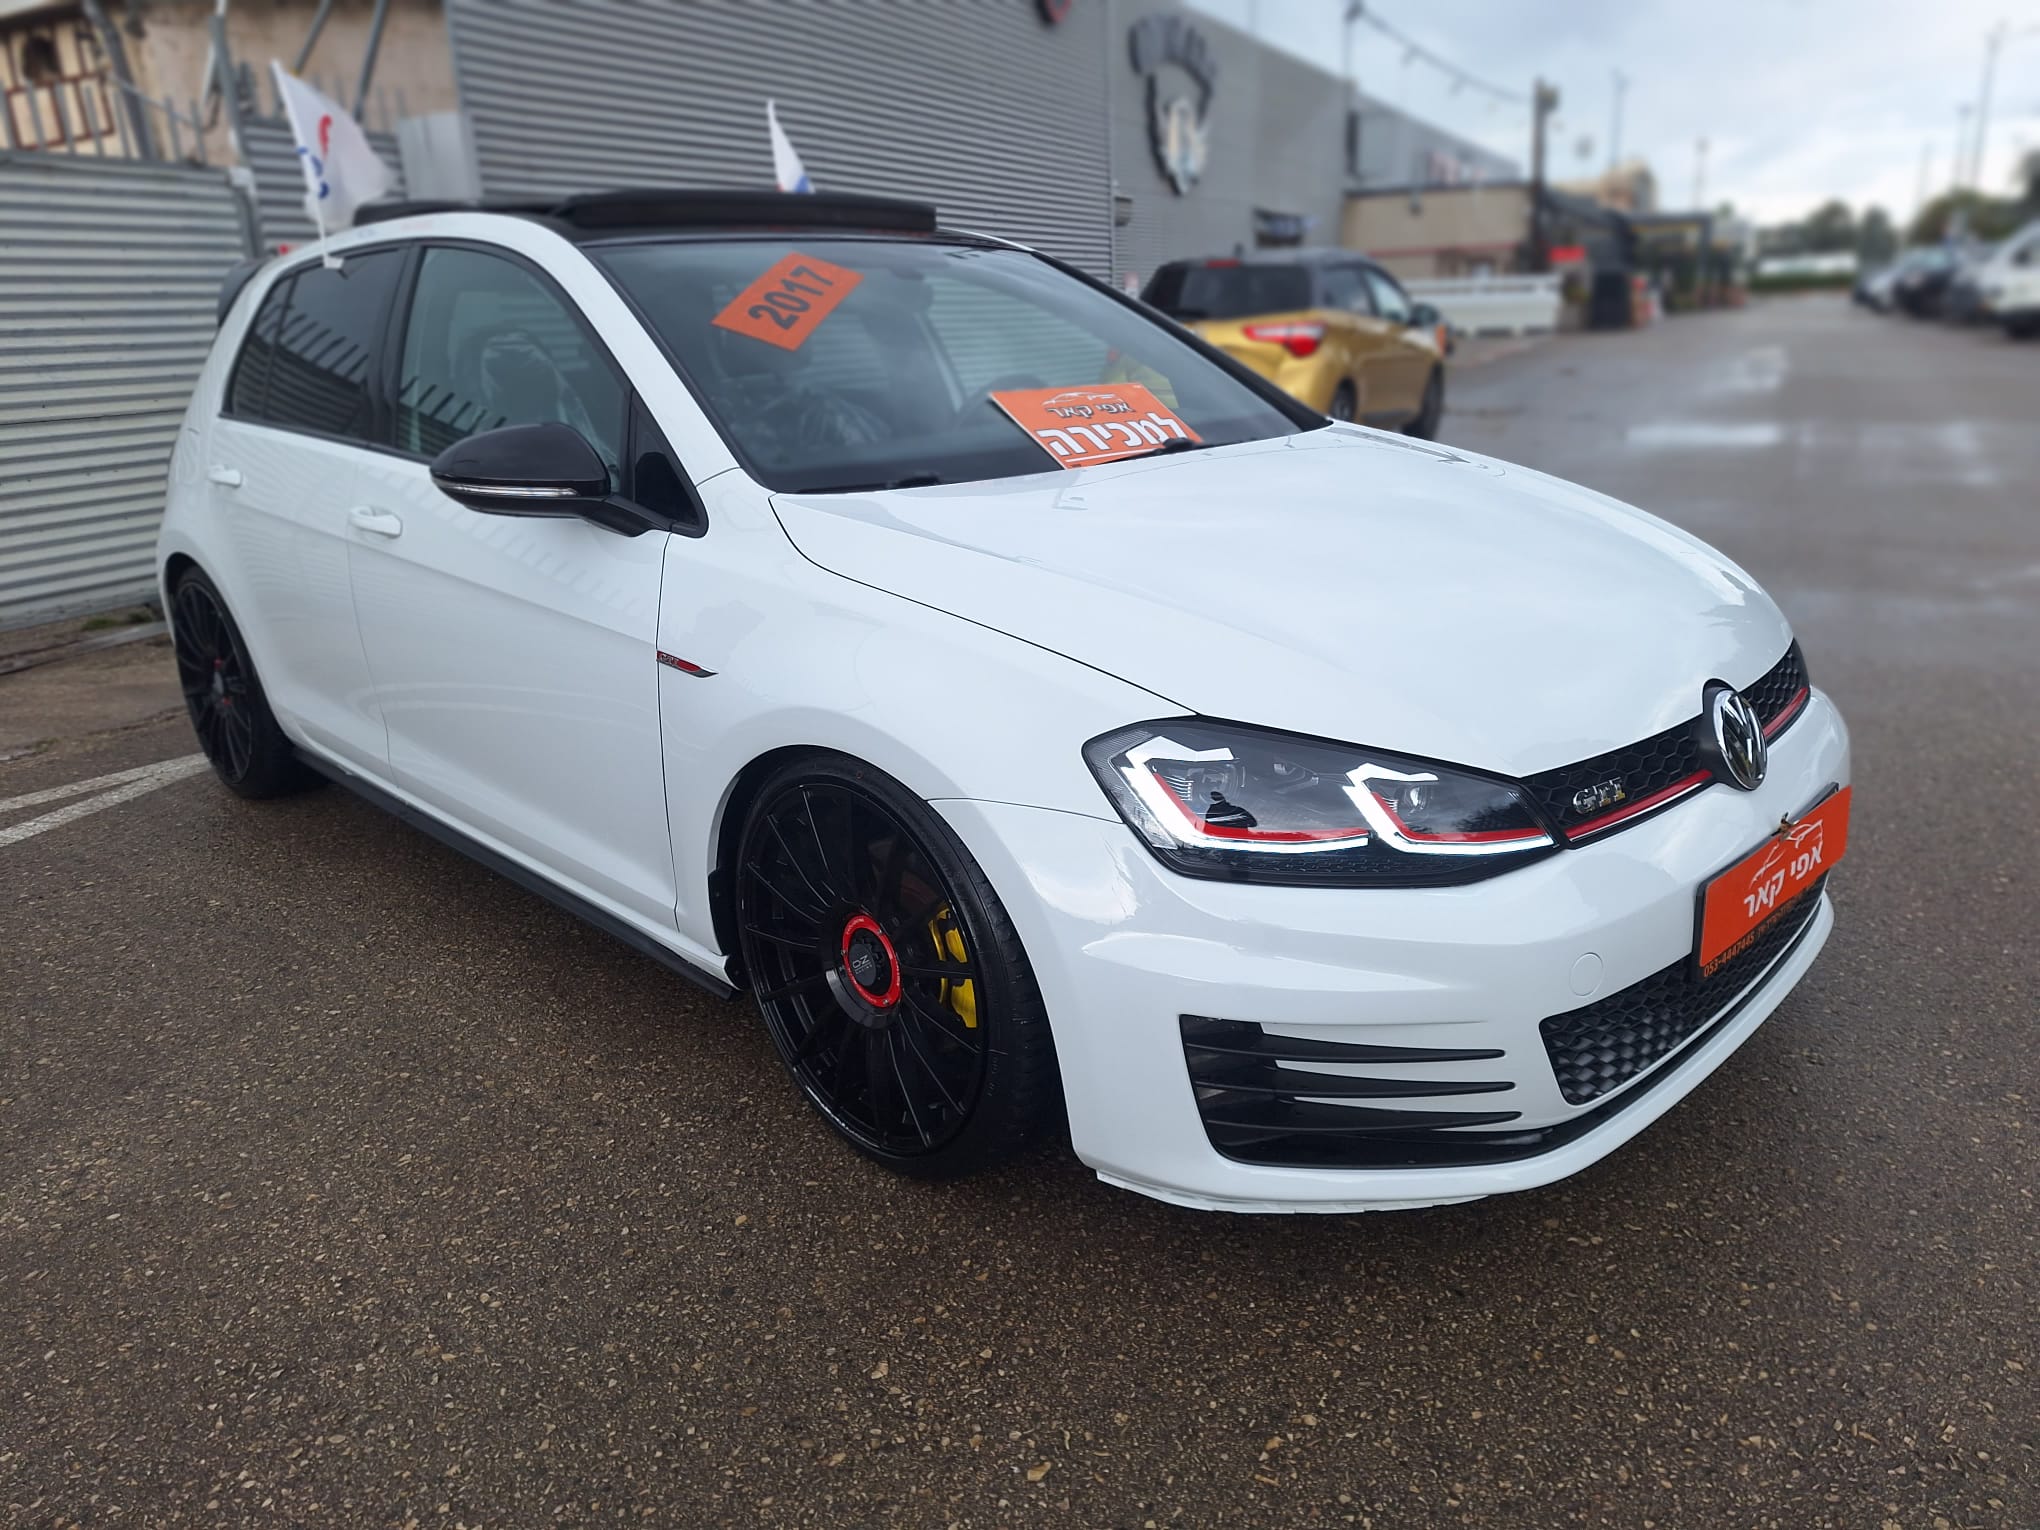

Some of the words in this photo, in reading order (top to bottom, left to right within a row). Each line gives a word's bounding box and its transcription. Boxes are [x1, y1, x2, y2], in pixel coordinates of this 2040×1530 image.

[747, 264, 833, 331] 2017
[1046, 405, 1094, 418] קאר
[1095, 402, 1133, 414] אפי
[1035, 412, 1188, 457] למכירה
[1573, 777, 1626, 814] GTI
[1790, 841, 1824, 881] אפי
[1743, 868, 1785, 917] קאר
[852, 954, 869, 968] OZ
